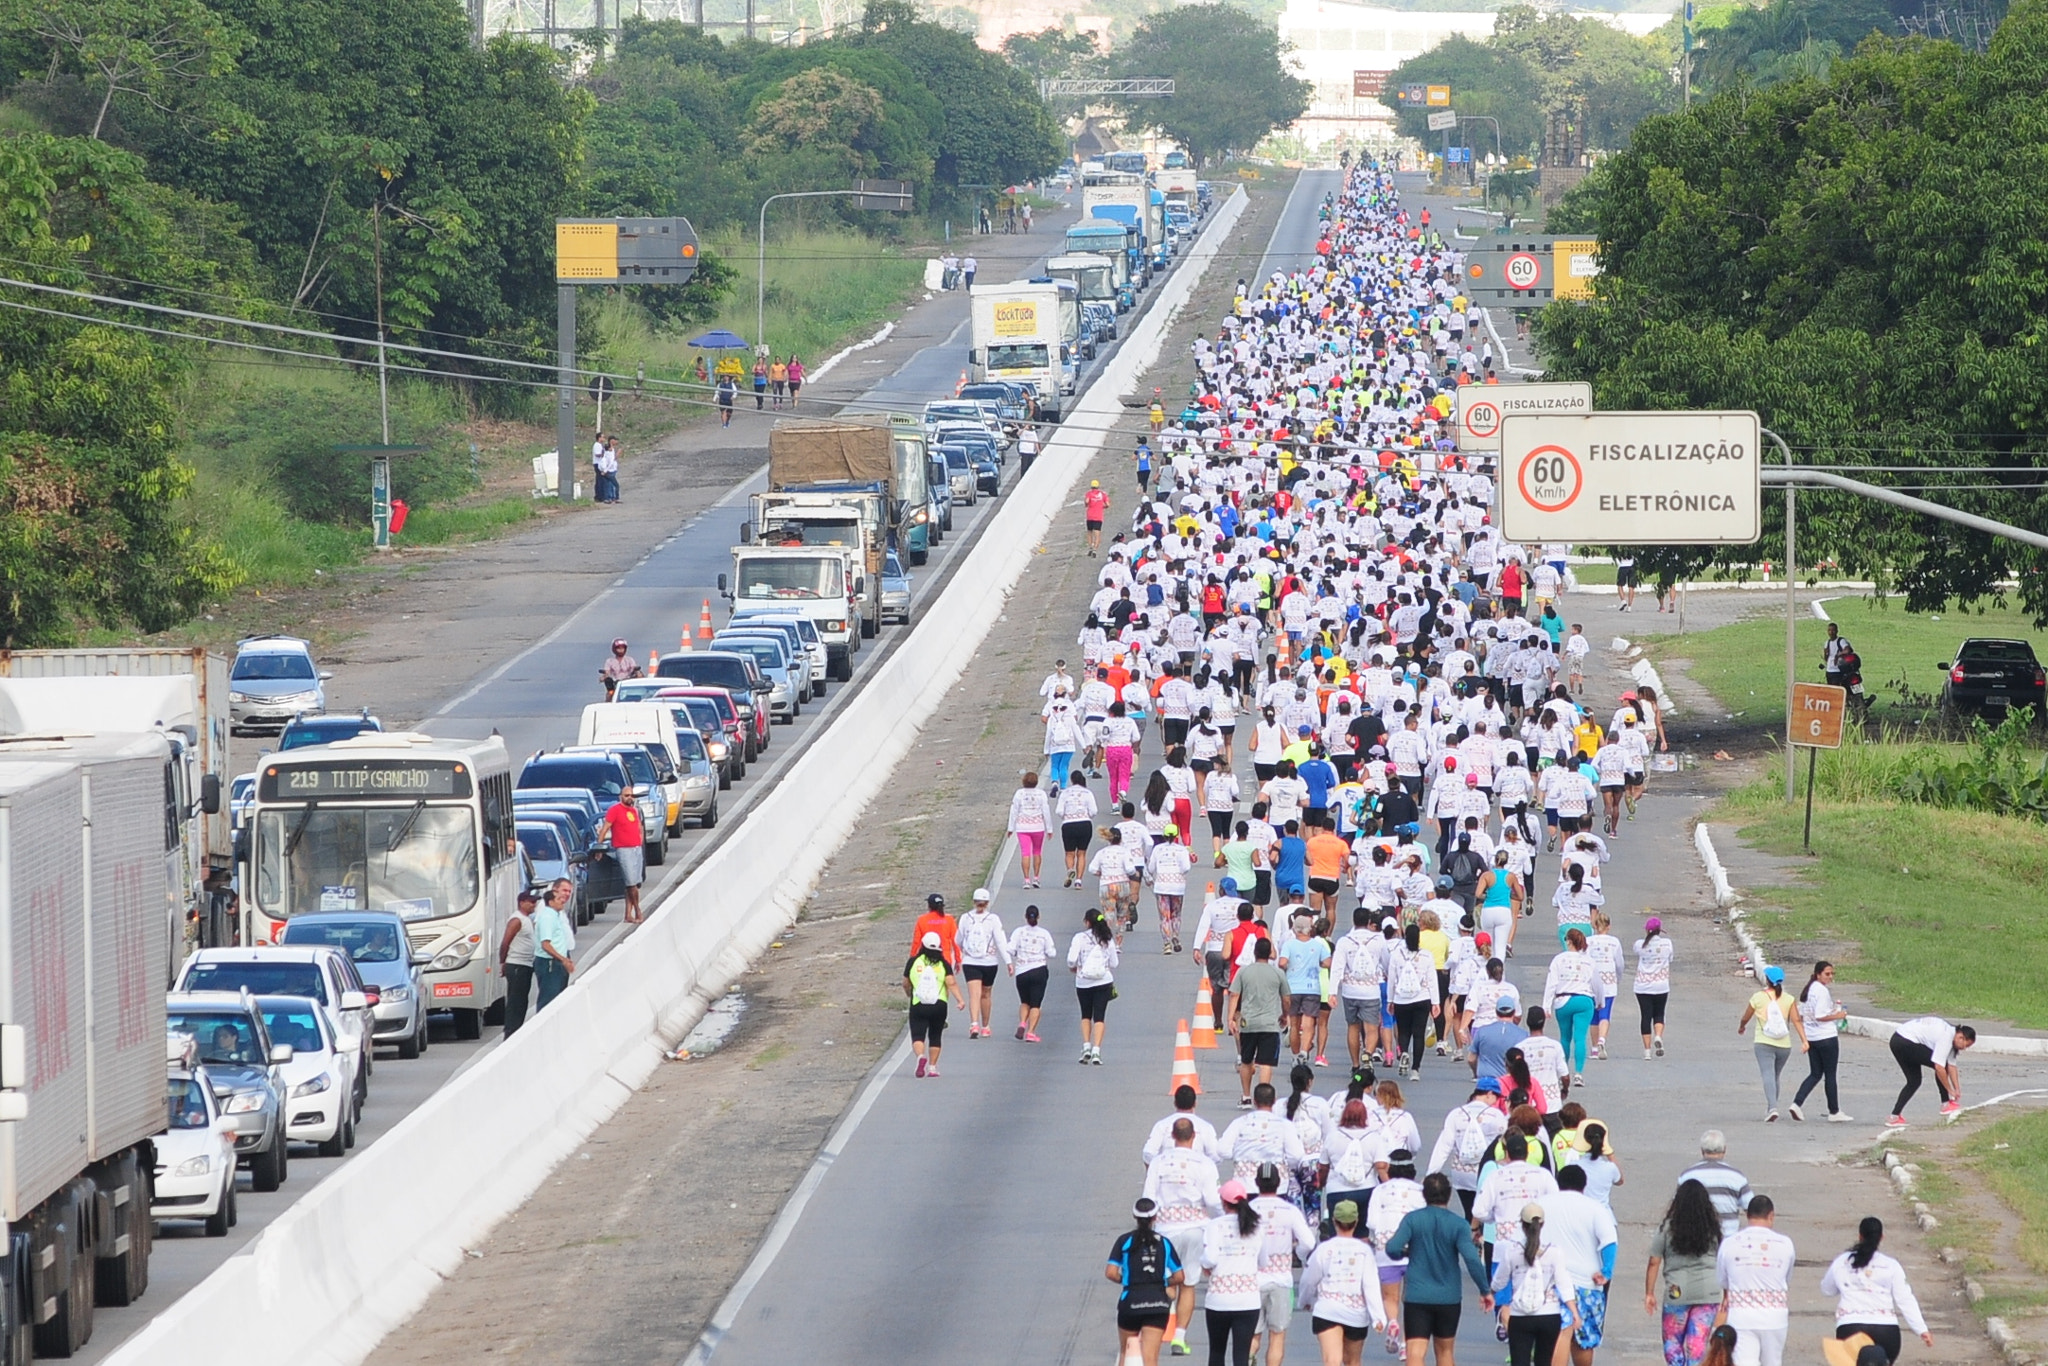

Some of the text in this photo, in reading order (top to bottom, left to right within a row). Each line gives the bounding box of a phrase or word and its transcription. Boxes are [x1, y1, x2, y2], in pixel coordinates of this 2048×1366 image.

[1512, 261, 1532, 275] 60
[1503, 397, 1584, 410] FISCALIZAÇÃO
[1474, 408, 1491, 421] 60
[1589, 439, 1744, 465] FISCALIZAÇÃO
[1533, 456, 1565, 483] 60
[1534, 485, 1566, 499] Km/h
[1599, 490, 1736, 511] ELETRÔNICA
[1804, 694, 1831, 712] km
[1810, 719, 1822, 736] 6
[290, 771, 318, 788] 219
